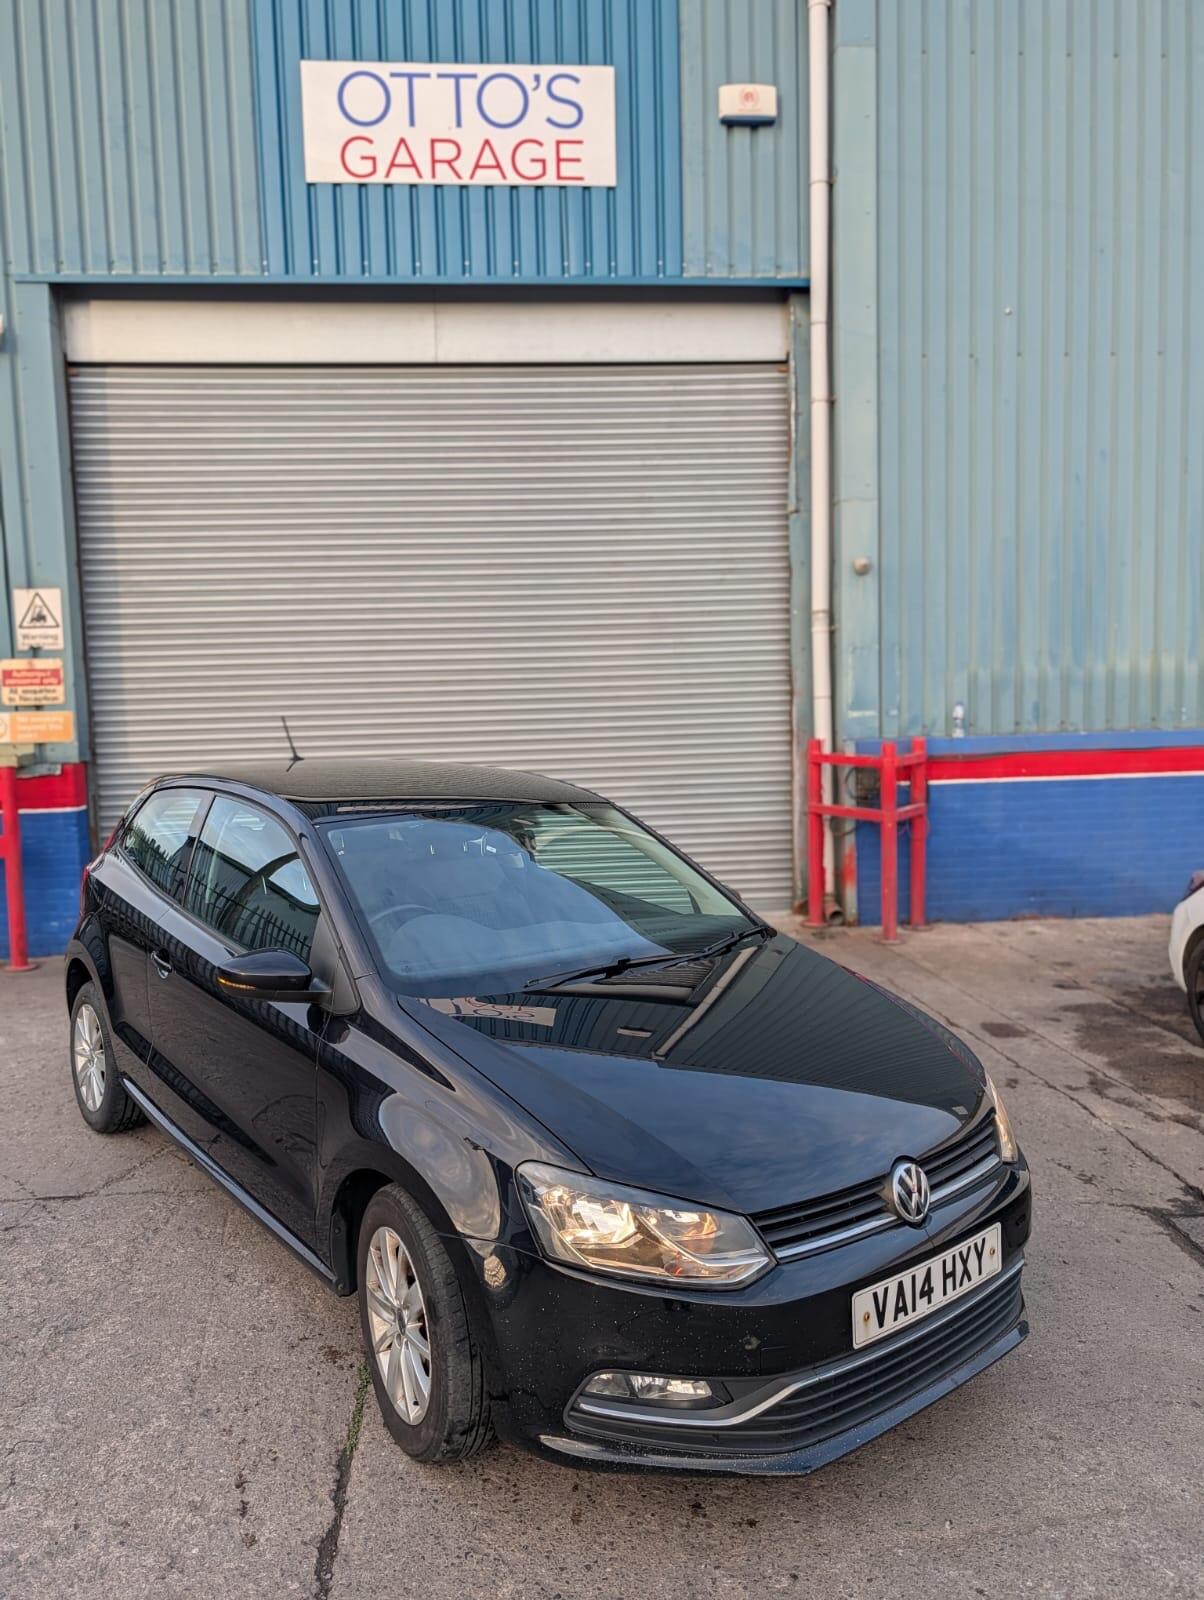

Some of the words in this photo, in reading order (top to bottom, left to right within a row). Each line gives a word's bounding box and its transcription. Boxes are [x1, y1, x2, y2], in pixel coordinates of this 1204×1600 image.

[337, 70, 584, 129] OTTO'S
[340, 136, 585, 181] GARAGE
[872, 1266, 934, 1328] VA14
[942, 1237, 986, 1297] HXY
